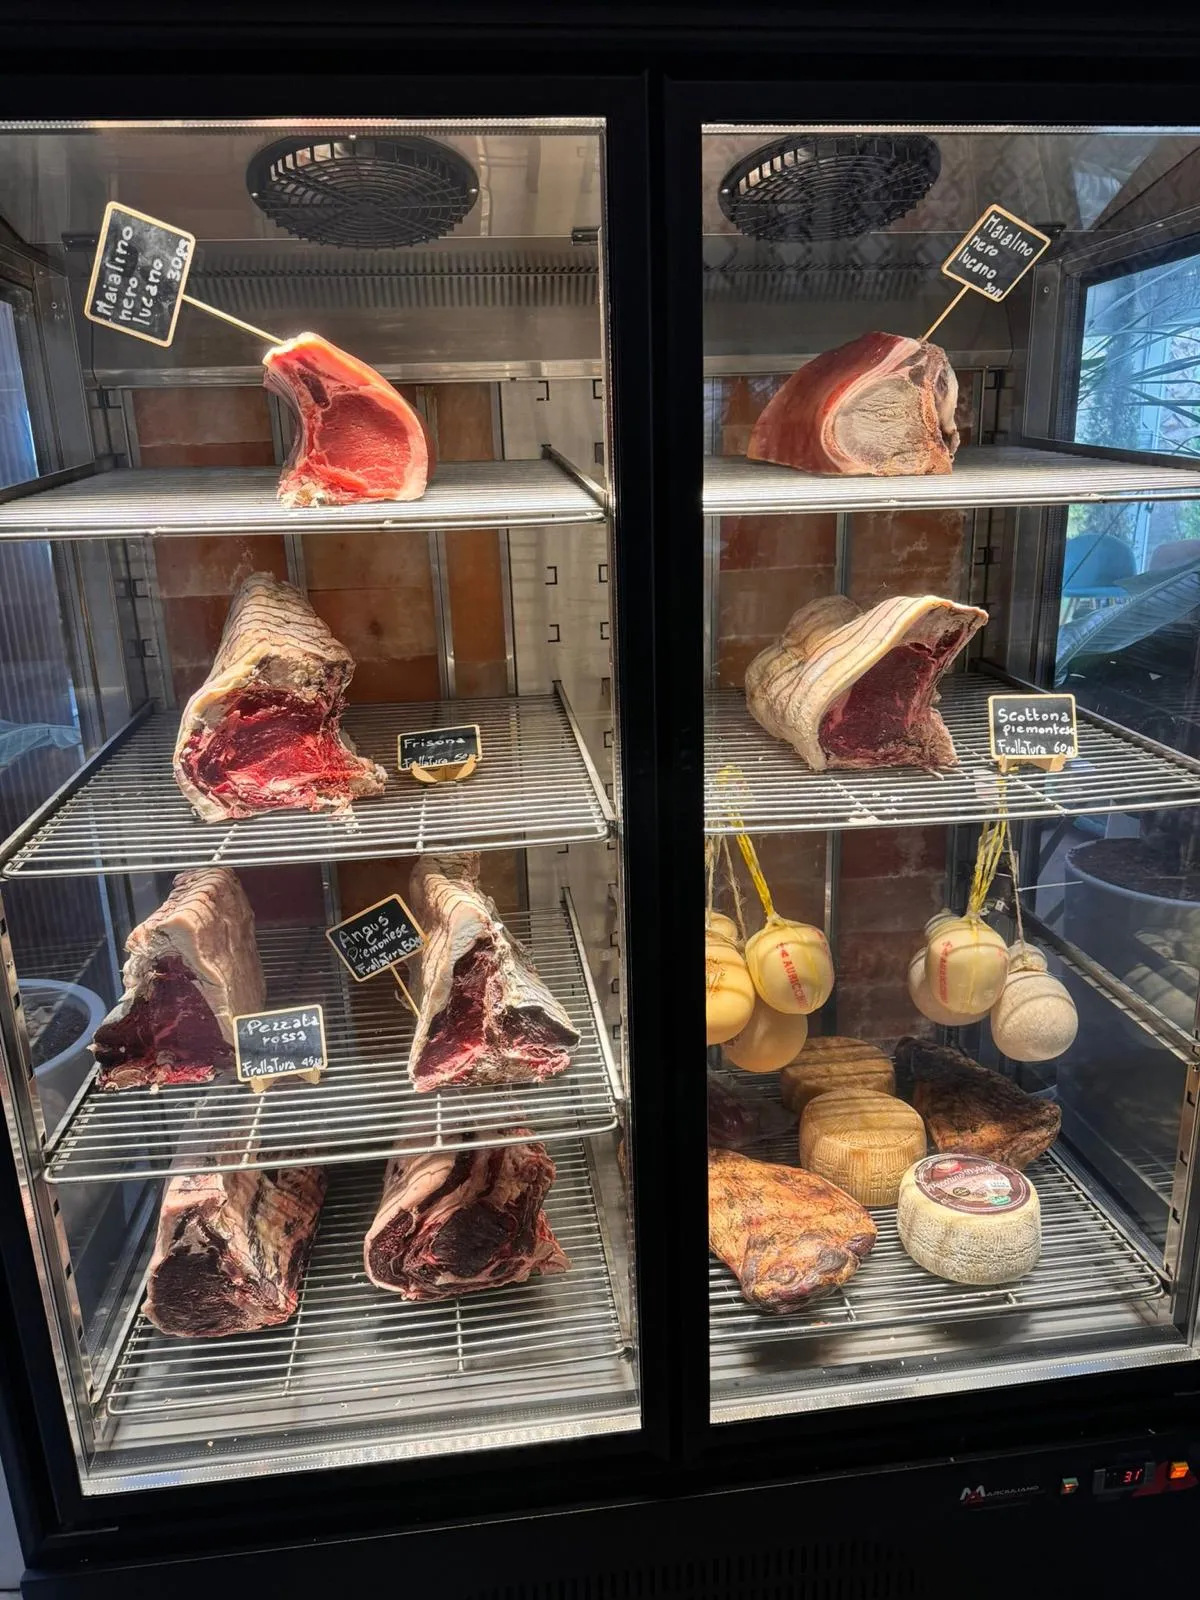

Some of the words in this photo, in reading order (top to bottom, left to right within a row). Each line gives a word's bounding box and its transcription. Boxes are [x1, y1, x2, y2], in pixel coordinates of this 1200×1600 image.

[969, 236, 998, 257] nero
[983, 215, 1034, 257] Maialino
[95, 226, 133, 316] Maialino
[958, 247, 997, 279] lucano
[119, 277, 138, 321] nero
[132, 258, 164, 325] lucano
[998, 707, 1070, 723] Scottona
[404, 737, 466, 749] Frisona
[339, 915, 390, 948] Angus
[247, 1013, 320, 1036] Pezzata
[262, 1030, 307, 1046] rossa
